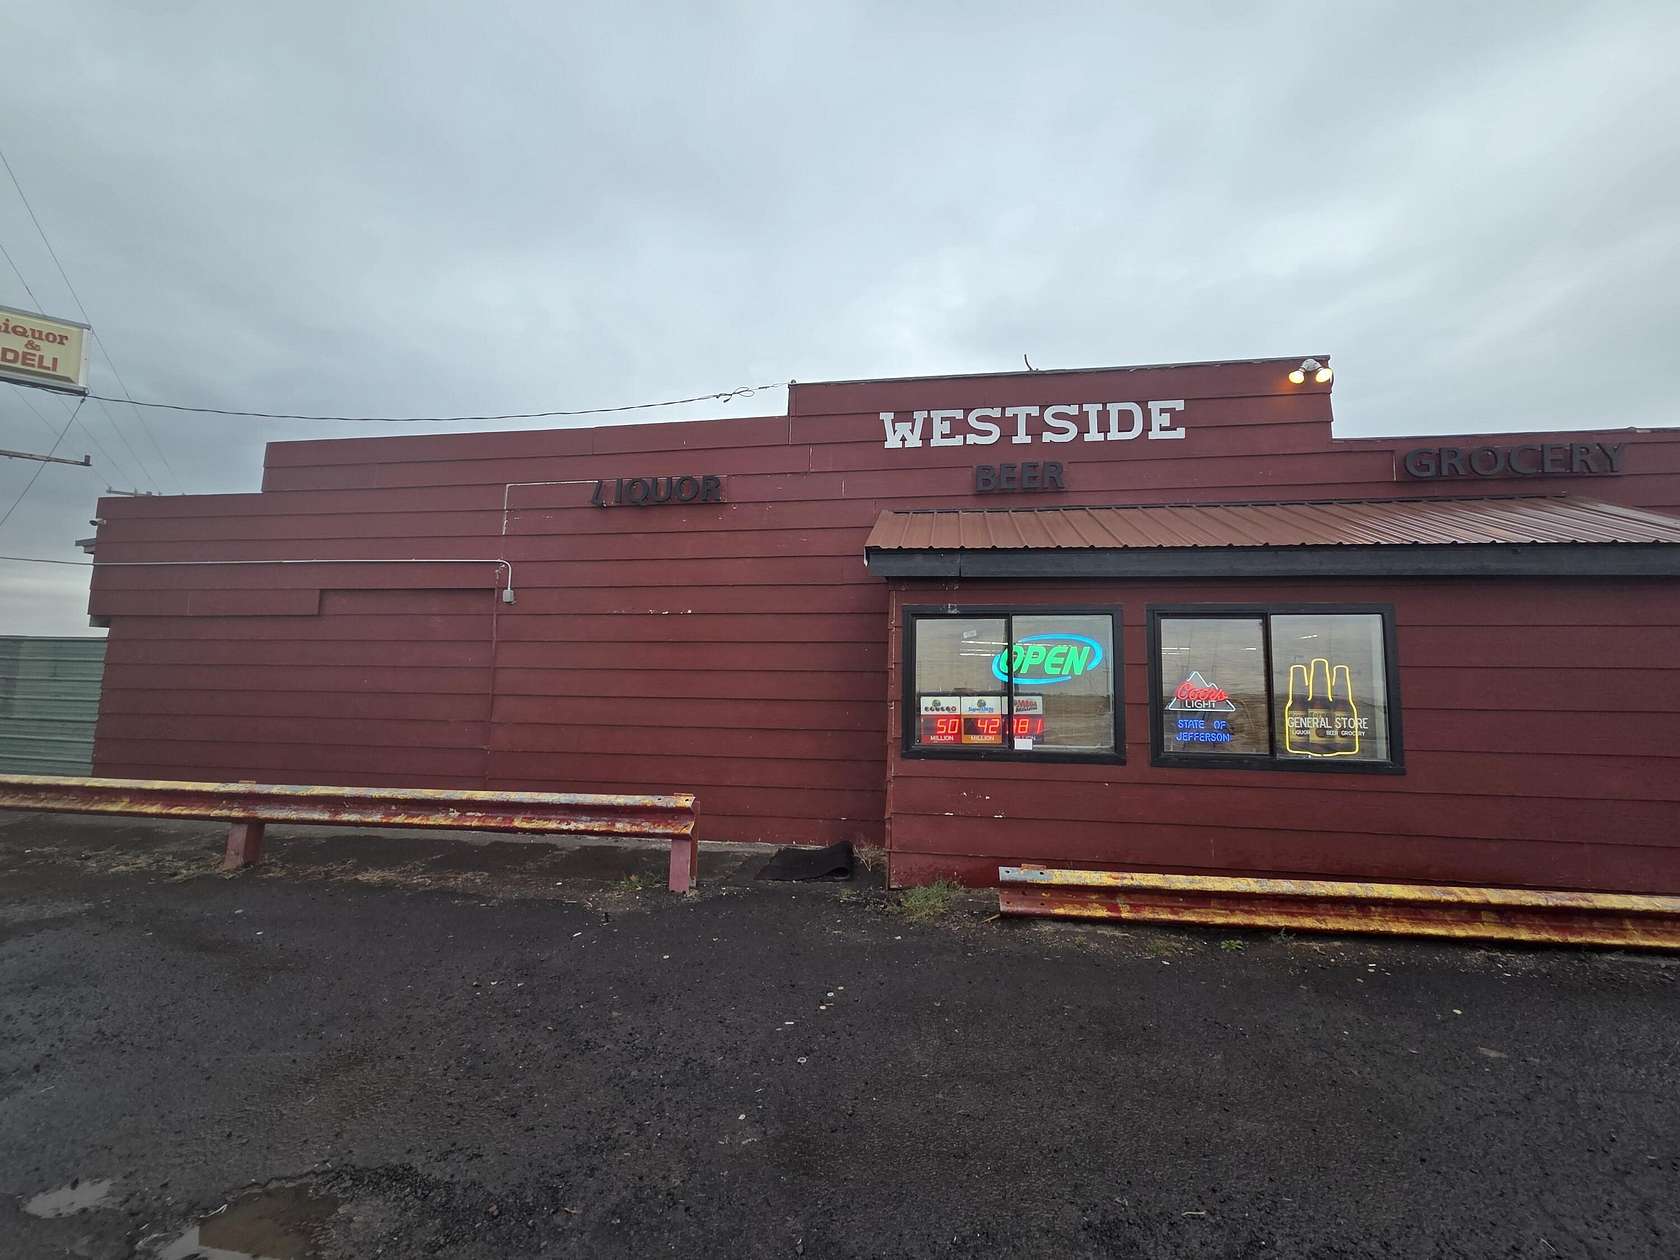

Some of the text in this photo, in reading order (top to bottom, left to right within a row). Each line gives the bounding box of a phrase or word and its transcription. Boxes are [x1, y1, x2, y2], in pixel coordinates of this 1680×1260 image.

[24, 340, 41, 351] &
[1, 347, 58, 372] DELI
[879, 400, 1185, 448] WESTSIDE
[1403, 443, 1622, 478] GROCERY
[975, 461, 1064, 492] BEER
[592, 475, 721, 508] LIQUOR
[1000, 645, 1091, 675] OPEN
[1177, 682, 1229, 701] Coors
[1185, 699, 1217, 709] LIGHT
[936, 718, 960, 734] 50
[976, 718, 1001, 734] 42
[1177, 719, 1227, 730] STATE OF
[1287, 716, 1369, 730] GENERAL STORE
[1176, 732, 1231, 742] JEFFERSON
